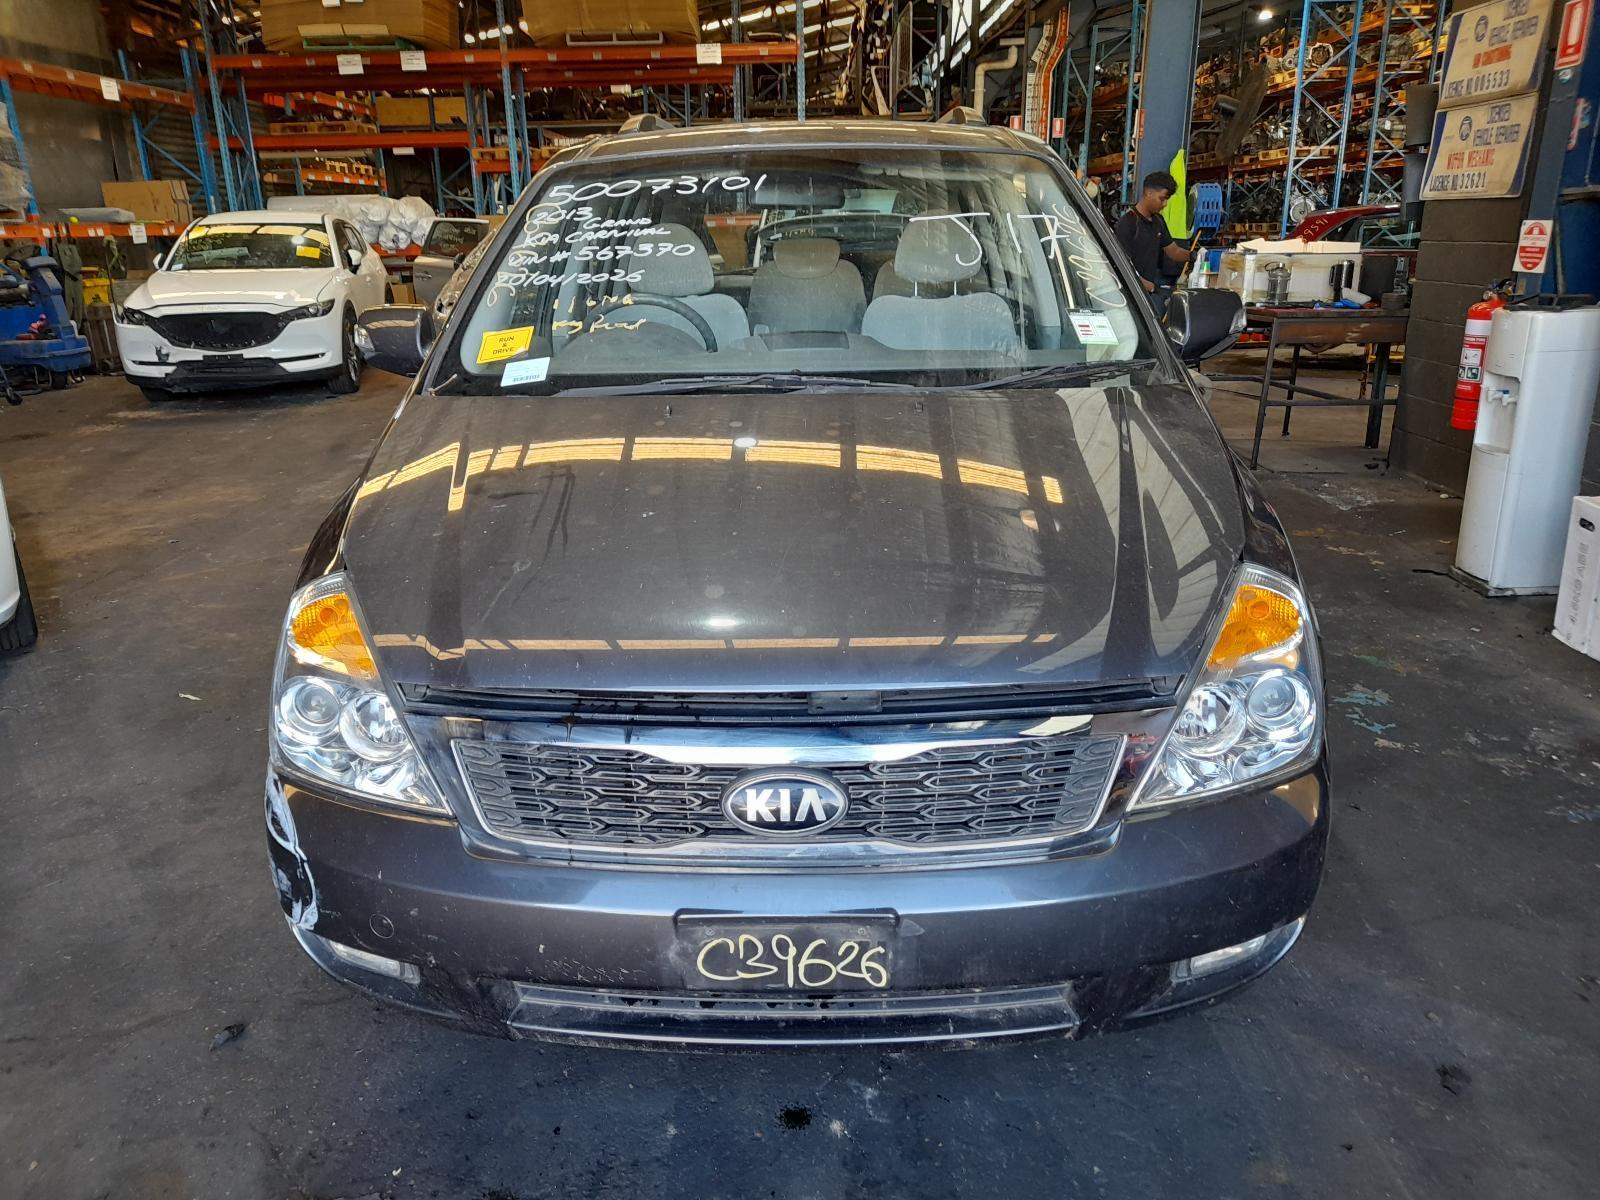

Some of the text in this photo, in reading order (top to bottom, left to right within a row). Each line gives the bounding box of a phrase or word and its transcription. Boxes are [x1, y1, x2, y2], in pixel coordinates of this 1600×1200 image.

[1446, 149, 1496, 170] MOTOR MECHANIC
[492, 347, 514, 355] DRIVE
[745, 788, 827, 822] KIA
